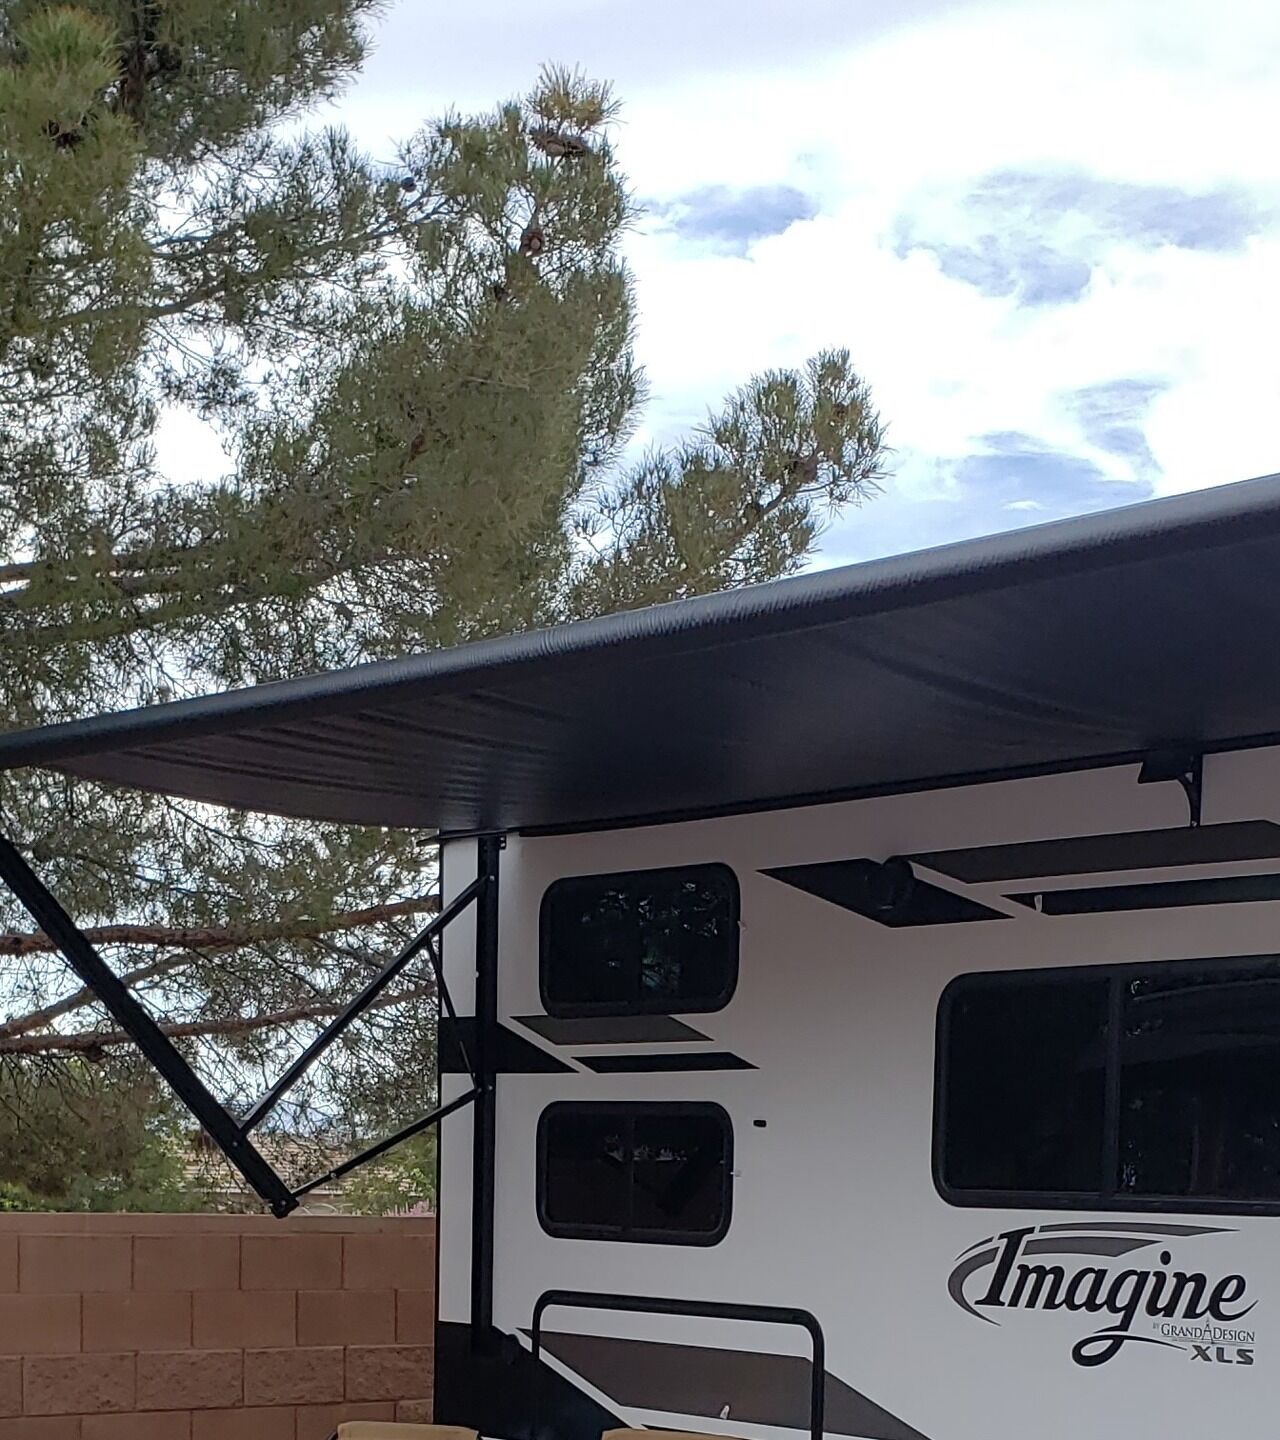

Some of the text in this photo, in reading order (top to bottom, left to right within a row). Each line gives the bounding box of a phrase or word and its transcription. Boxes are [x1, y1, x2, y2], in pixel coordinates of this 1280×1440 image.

[975, 1226, 1259, 1367] Imagine
[1161, 1323, 1202, 1338] GRAND
[1213, 1327, 1255, 1342] DESIGN
[1190, 1344, 1254, 1365] XLS
